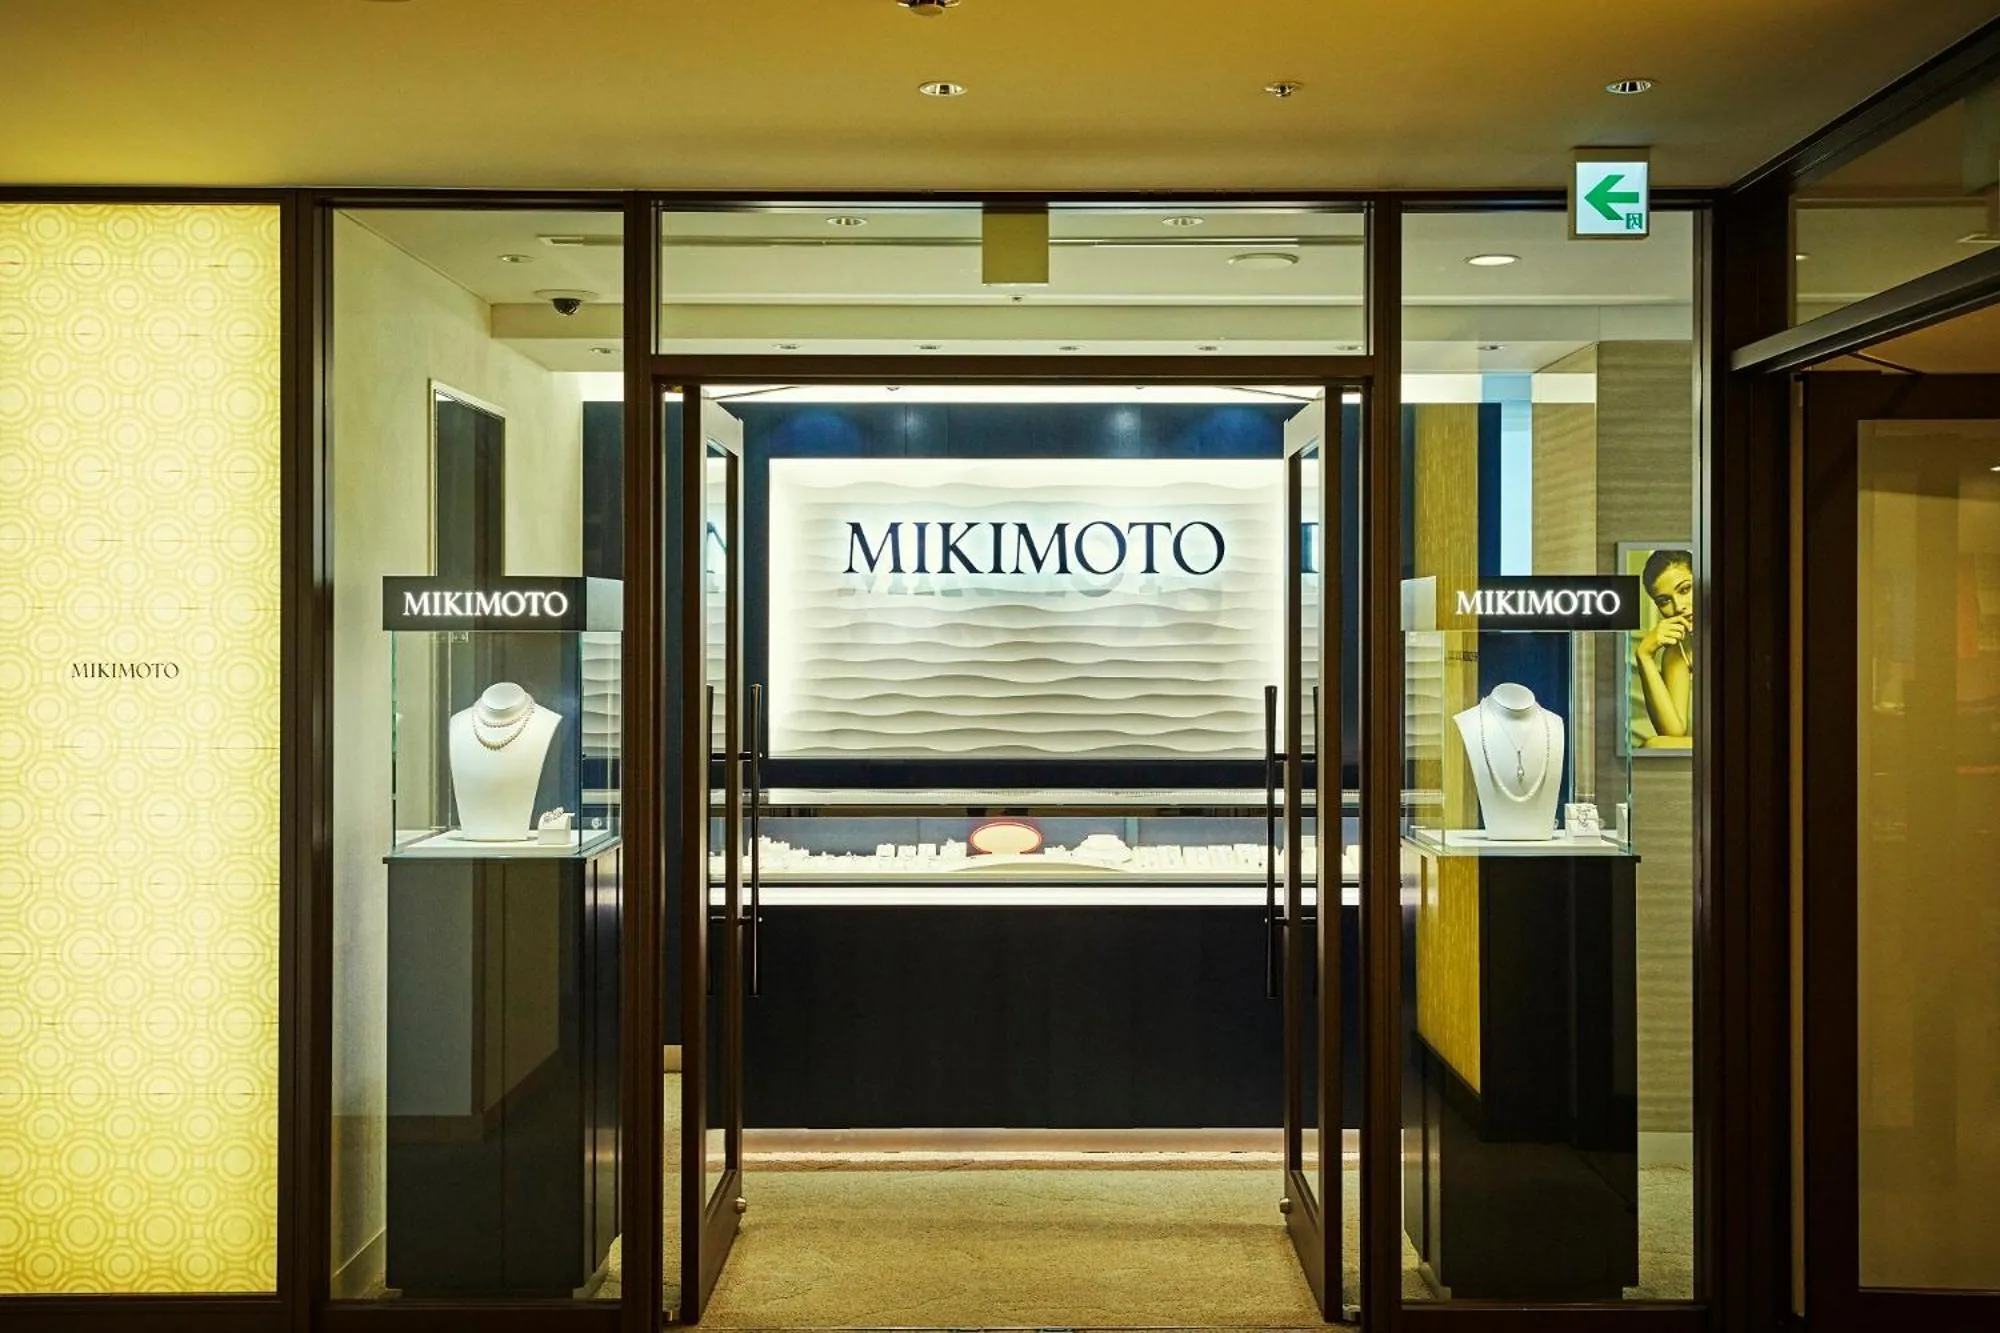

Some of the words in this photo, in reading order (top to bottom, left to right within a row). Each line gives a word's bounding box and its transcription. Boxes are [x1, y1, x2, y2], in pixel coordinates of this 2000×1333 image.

[843, 521, 1225, 575] MIKIMOTO
[402, 590, 568, 617] MIKIMOTO
[1456, 590, 1621, 616] MIKIMOTO
[72, 662, 179, 679] MIKIMOTO
